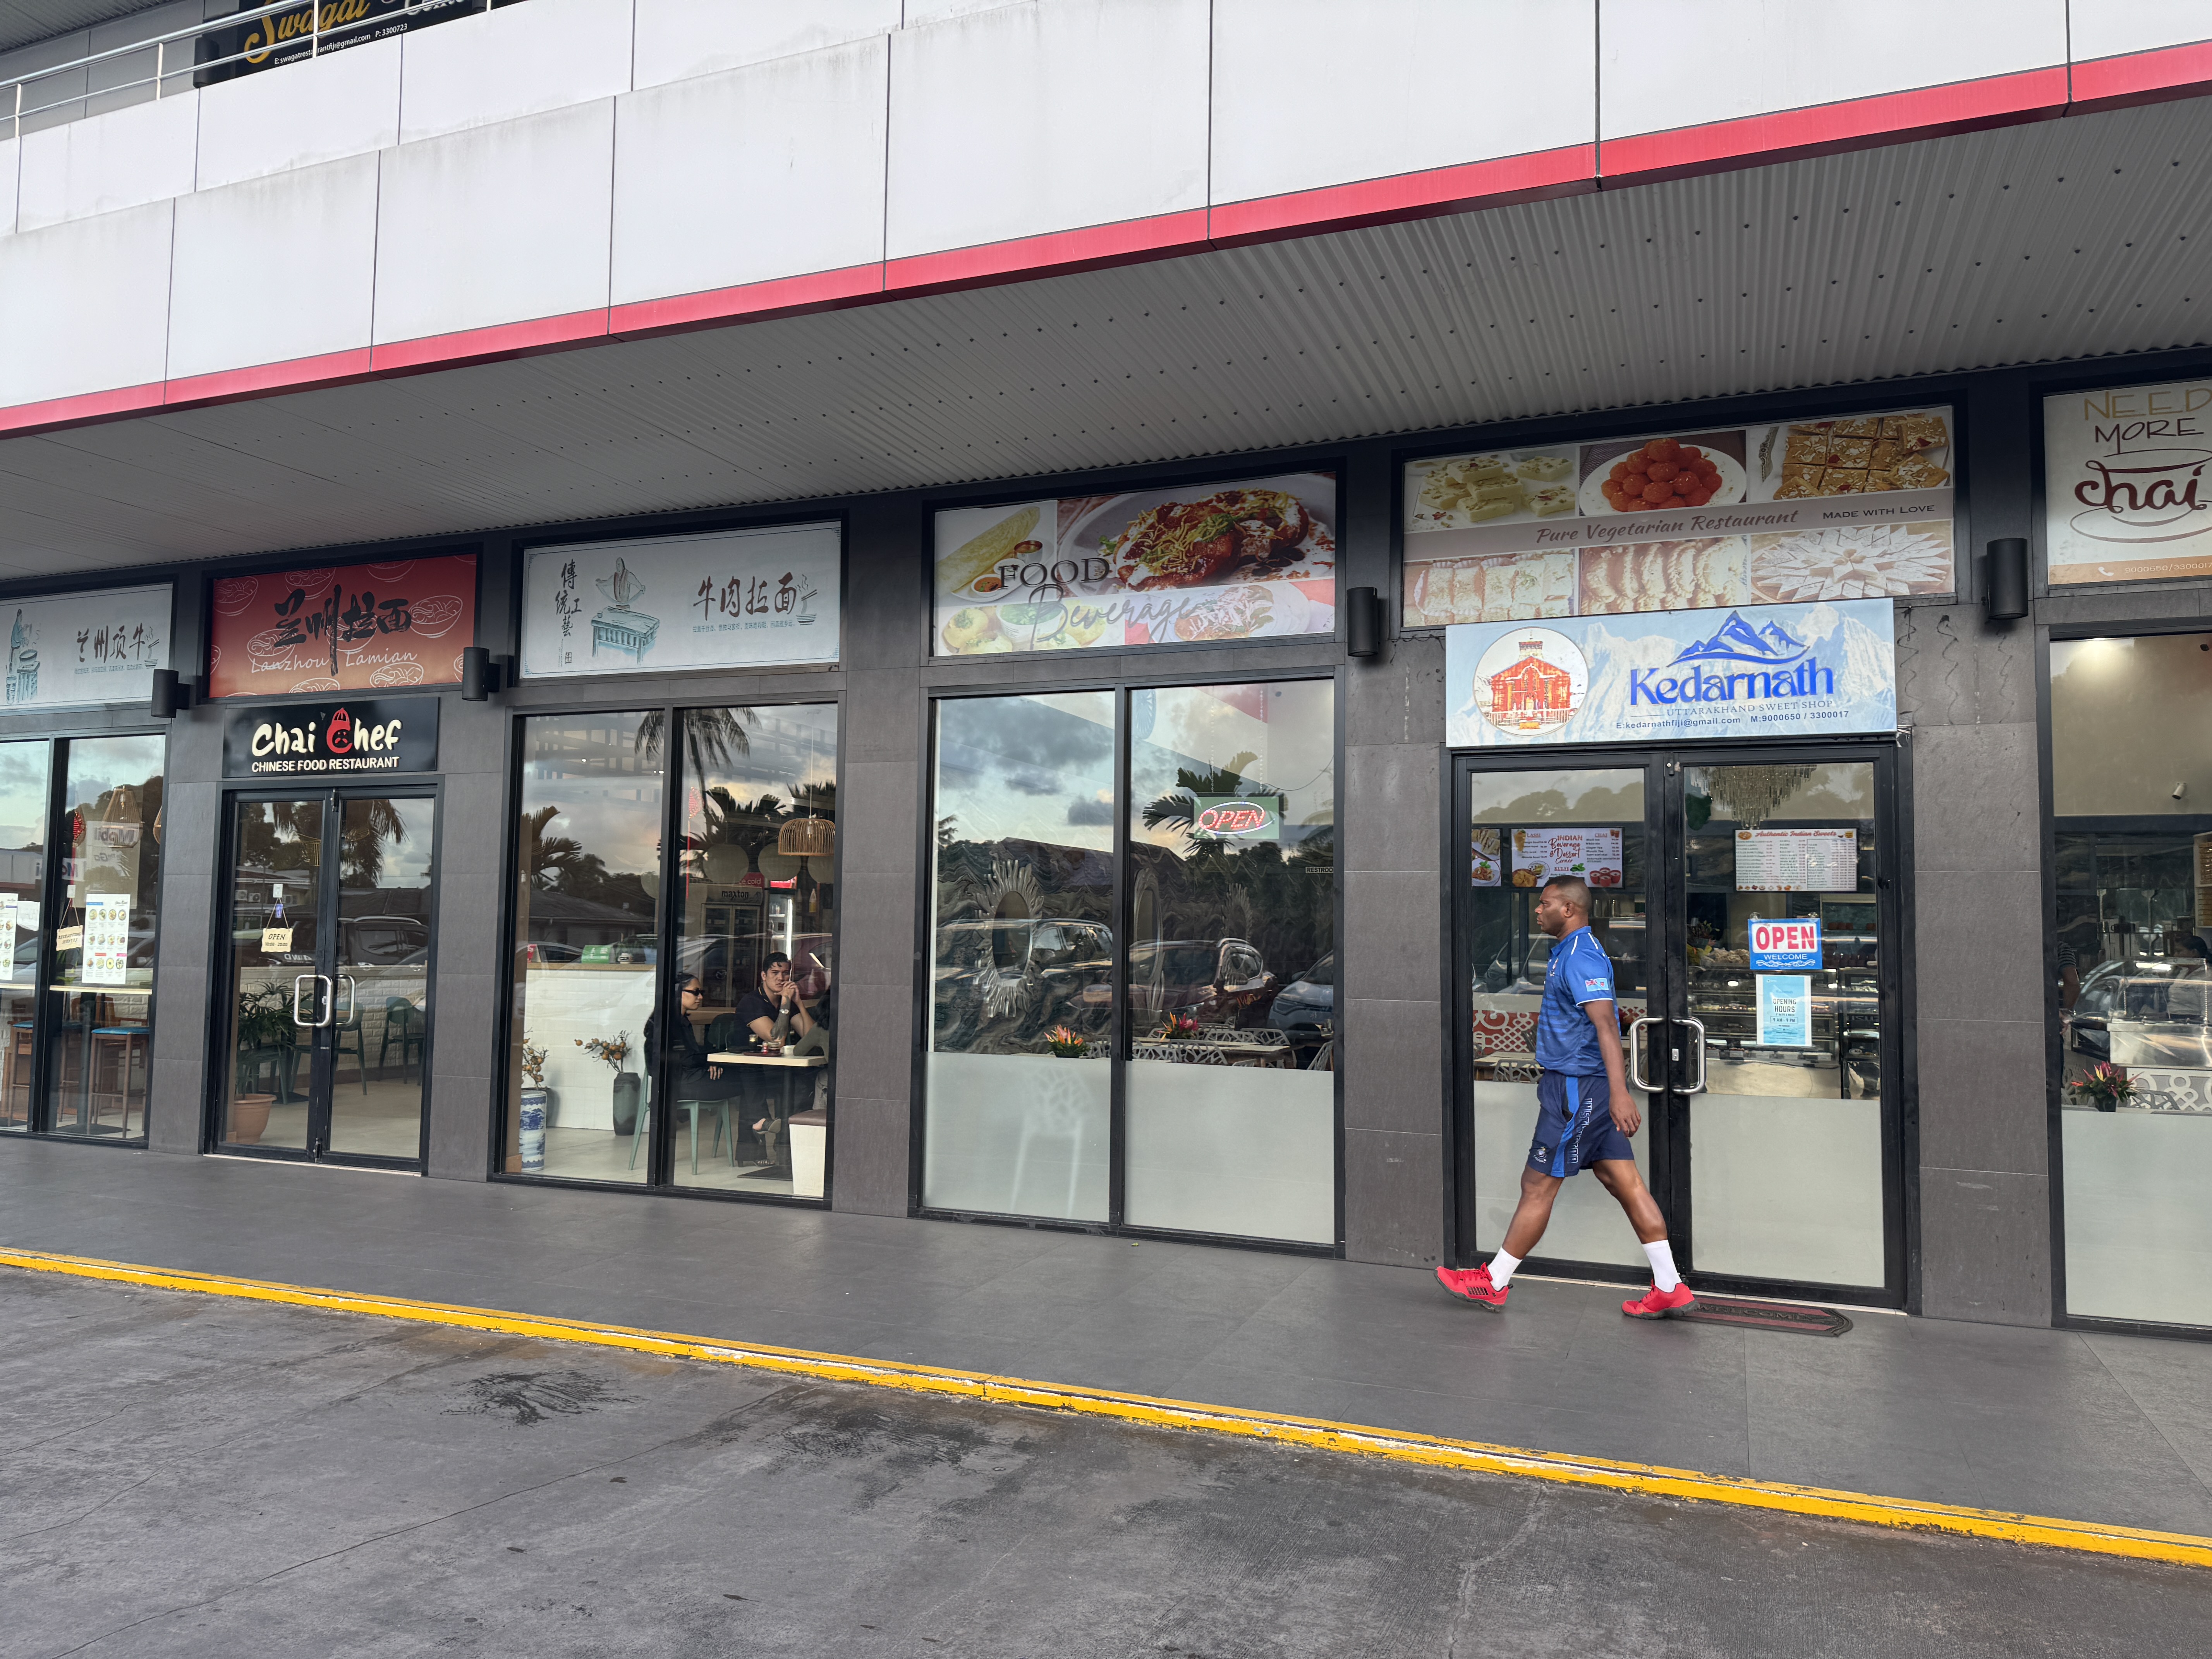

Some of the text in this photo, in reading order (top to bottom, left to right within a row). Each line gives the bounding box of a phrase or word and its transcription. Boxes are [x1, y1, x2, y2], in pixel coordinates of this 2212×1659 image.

[280, 34, 371, 64] swagatrestrantfiji@gmail.com
[382, 23, 408, 36] 3300723
[2084, 388, 2212, 421] NEED
[2095, 417, 2204, 454] MORE
[1536, 527, 1578, 543] Pure
[1587, 519, 1684, 542] Vegetarian
[1691, 510, 1799, 532] Restaurant
[999, 558, 1109, 589] FOOD
[2125, 562, 2212, 573] 9000650/3300017
[693, 572, 797, 621] 牛肉拉面
[251, 647, 417, 673] Lanzhou Lamian
[1630, 657, 1834, 706] Kedarnath
[1667, 700, 1833, 716] UTTARAKHAND SWEET SHOP
[1751, 713, 1801, 722] M:9000650
[1810, 711, 1849, 719] 3300017
[252, 708, 402, 757] Chai Chef
[252, 756, 400, 773] CHINESE FOOD RESTAURANT
[1198, 809, 1266, 830] OPEN
[1548, 838, 1580, 850] Beverage
[1553, 848, 1582, 859] Dessert
[722, 890, 749, 901] maxton
[1756, 926, 1815, 950] OPEN
